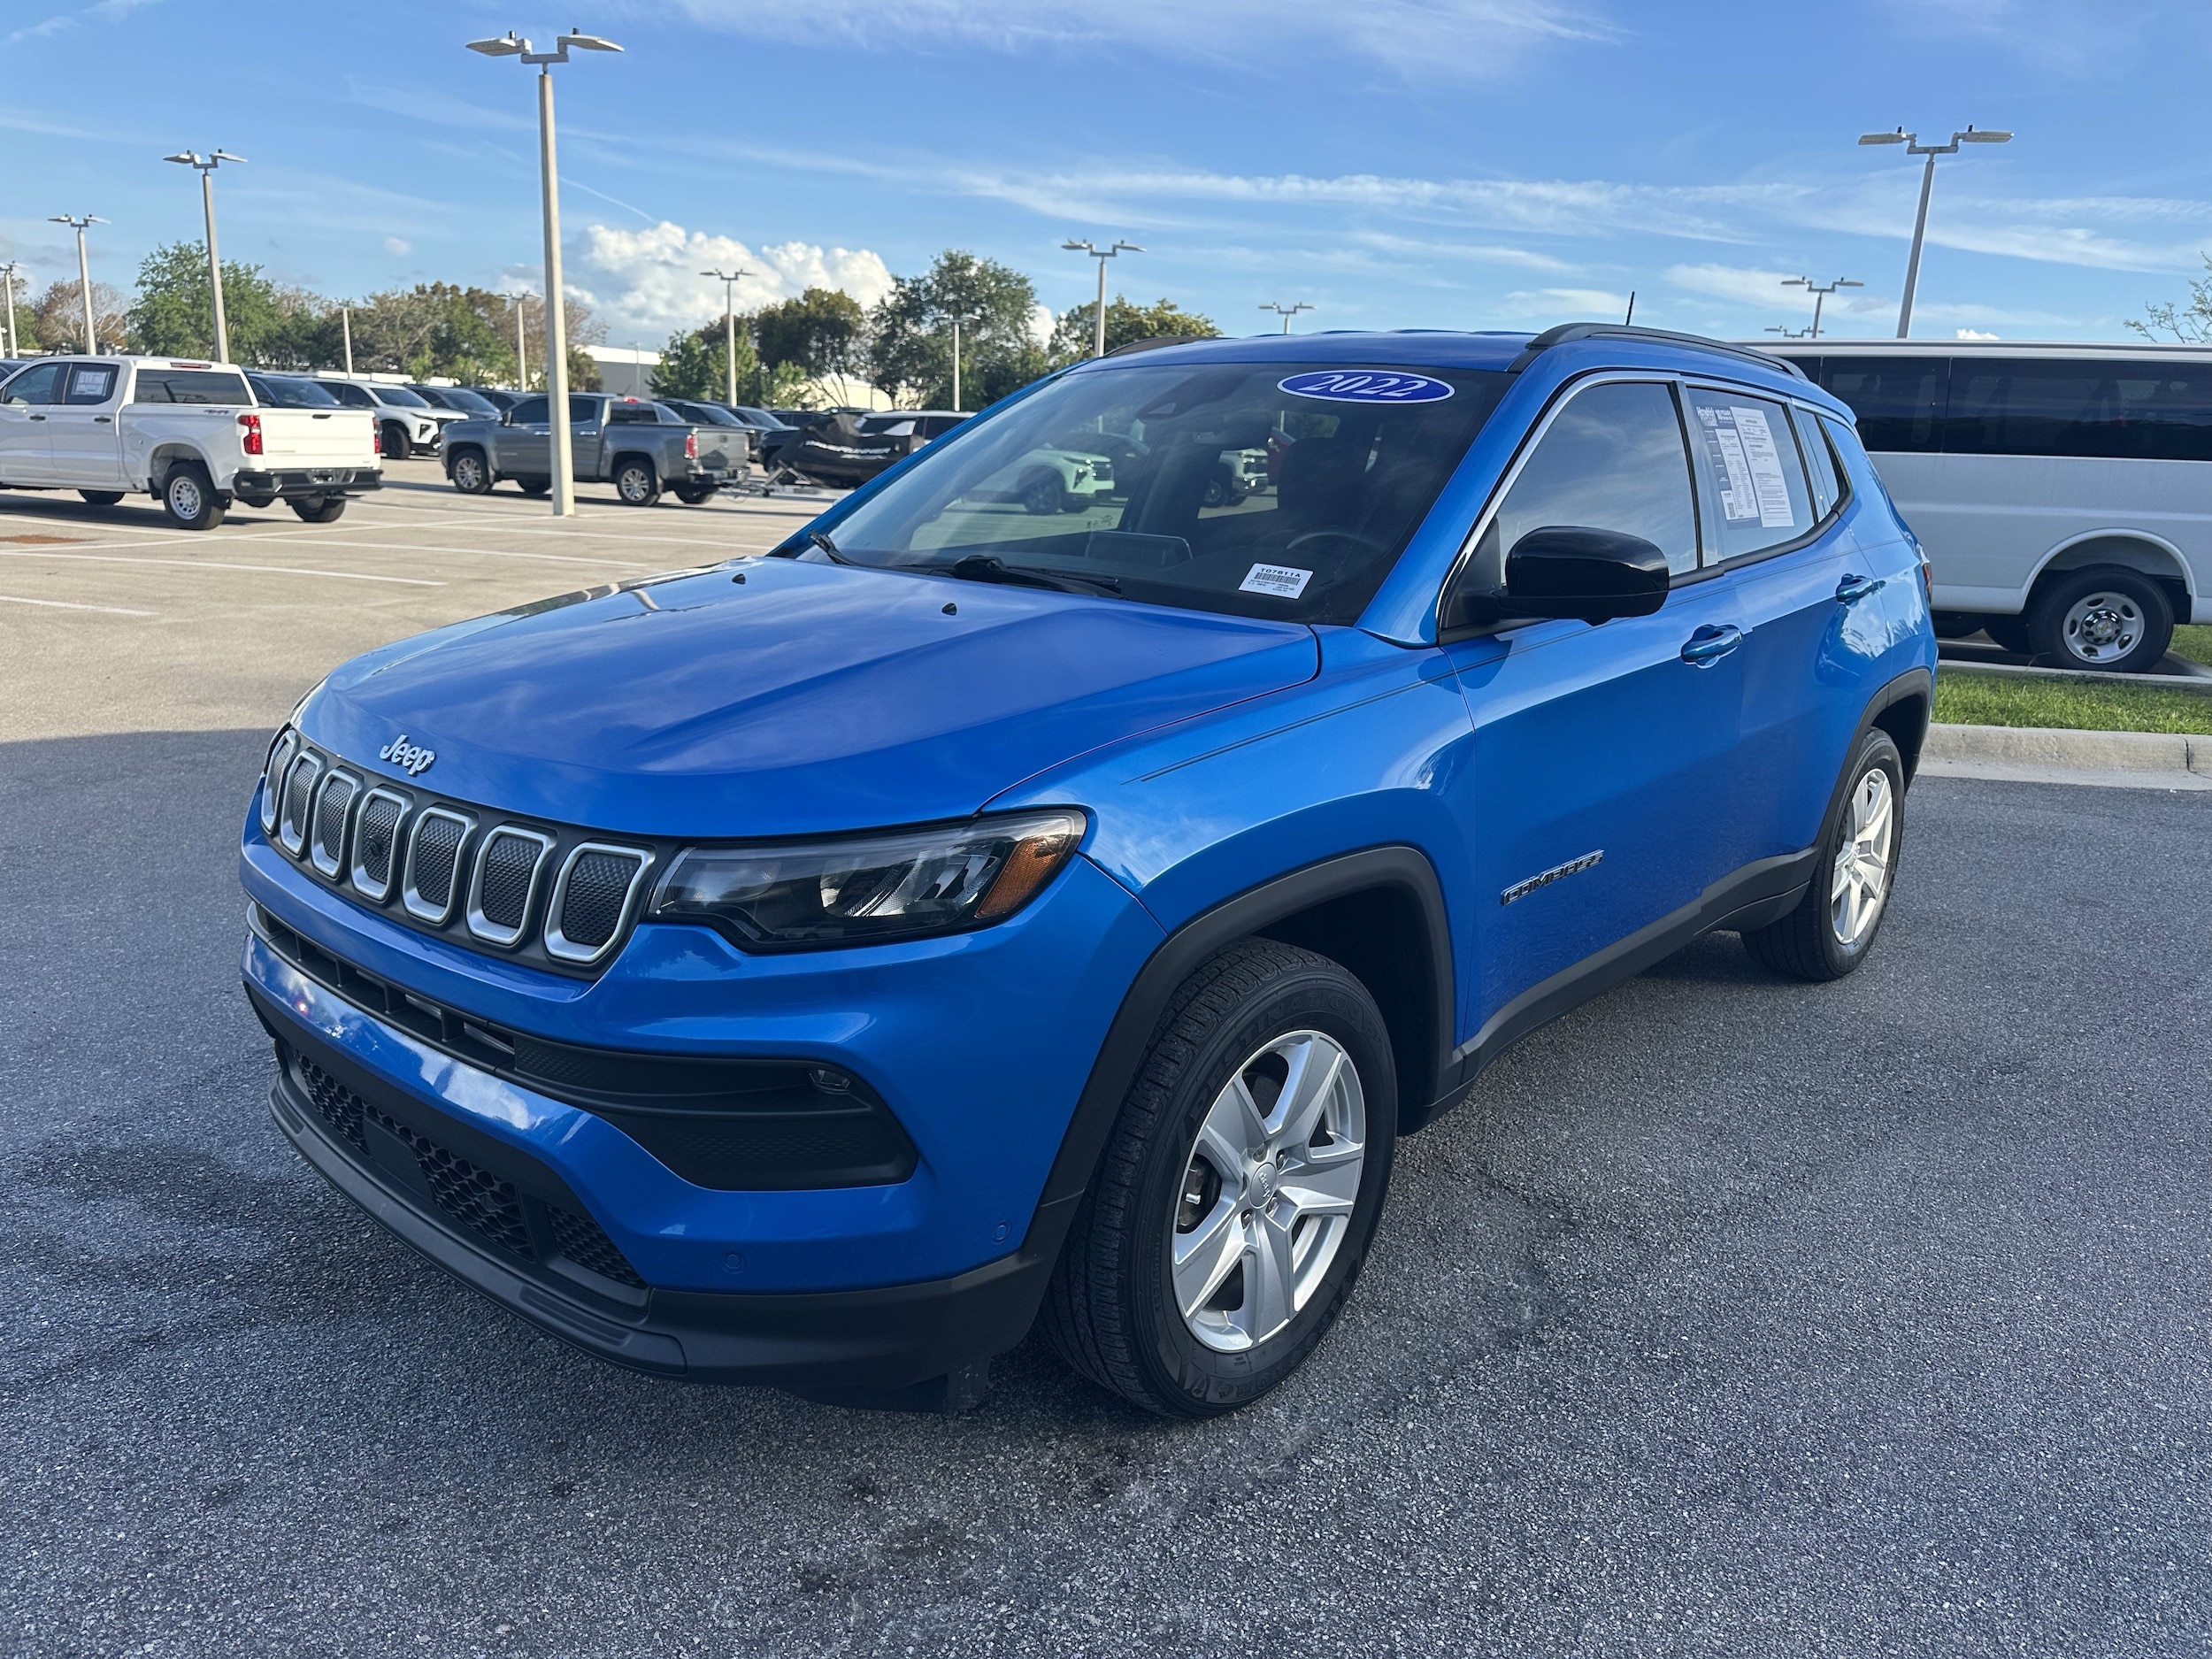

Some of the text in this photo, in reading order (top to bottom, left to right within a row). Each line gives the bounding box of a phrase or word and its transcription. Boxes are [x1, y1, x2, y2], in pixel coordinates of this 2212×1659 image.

[1296, 374, 1428, 397] 2022
[1260, 567, 1301, 578] T07811A
[379, 733, 436, 777] Jeep
